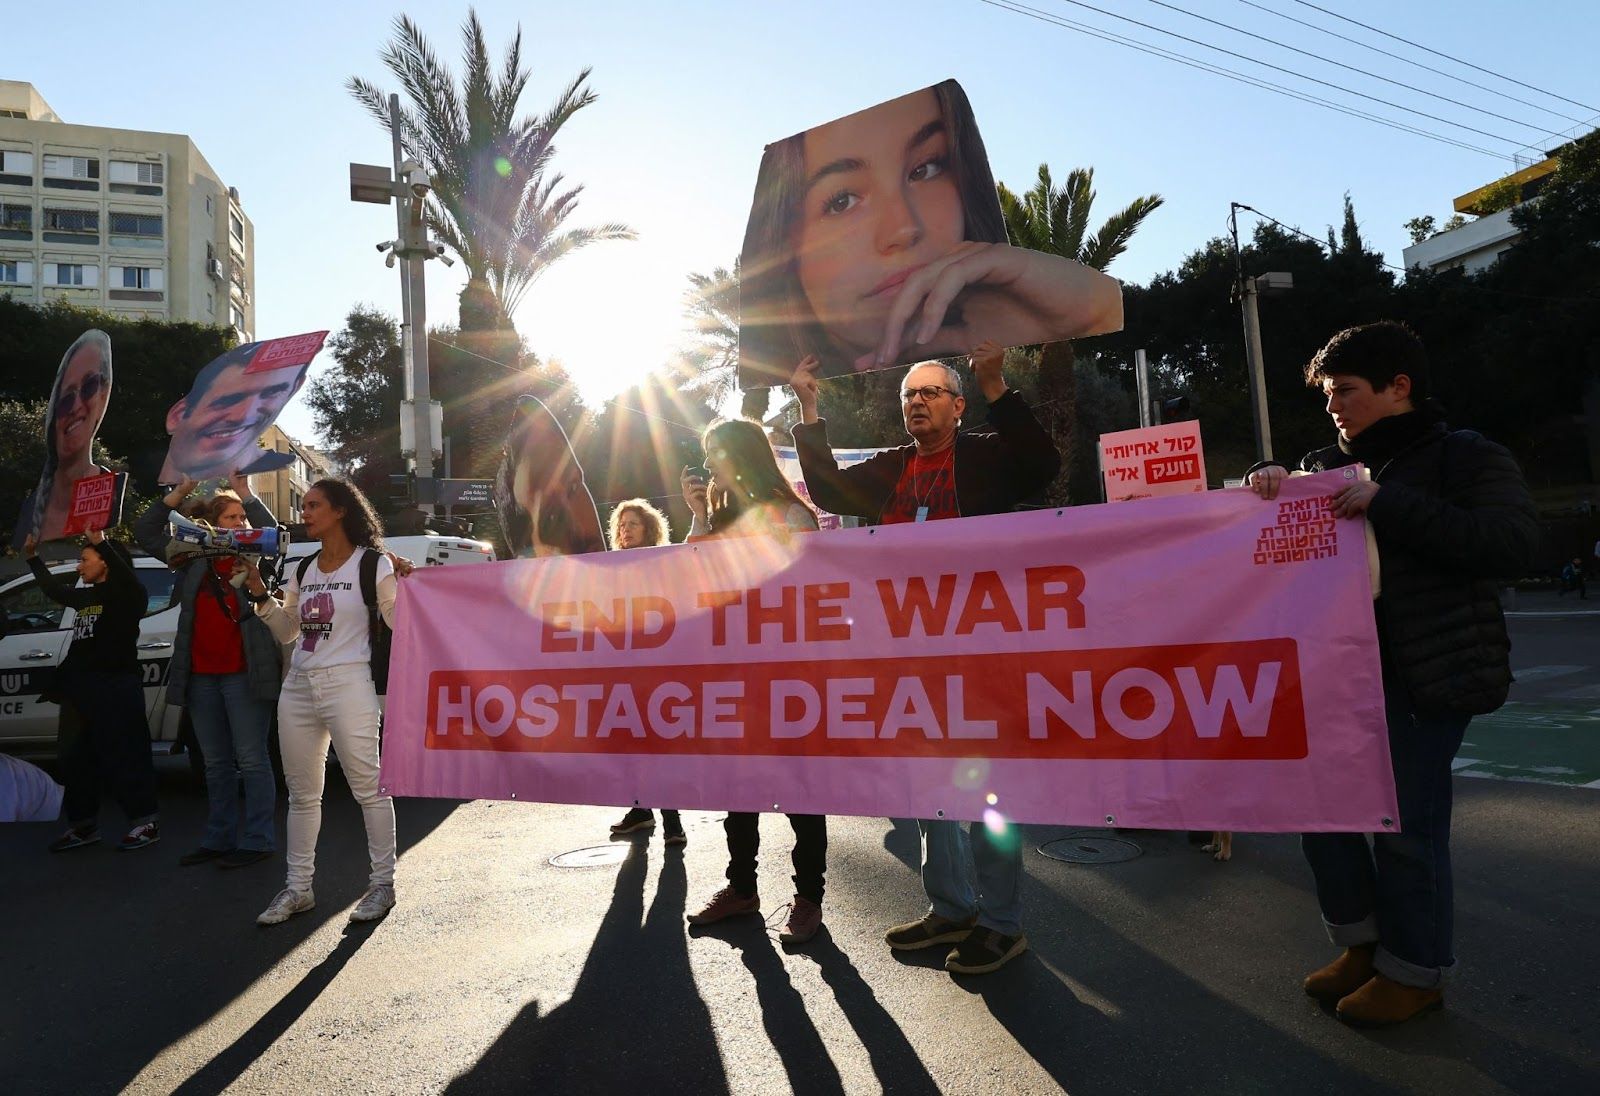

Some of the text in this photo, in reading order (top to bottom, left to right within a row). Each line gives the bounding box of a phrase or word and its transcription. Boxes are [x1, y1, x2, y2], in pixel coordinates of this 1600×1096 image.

[1163, 435, 1196, 452] קול
[1151, 459, 1194, 480] זועק
[79, 479, 112, 497] הופקרו
[75, 496, 110, 514] למותם.
[1279, 494, 1332, 513] מחאת
[1277, 508, 1336, 525] הנשים
[1261, 519, 1336, 539] להחזרת
[1256, 532, 1337, 552] החטופות
[1253, 545, 1338, 565] והחטופים
[541, 565, 1086, 653] END THE WAR
[0, 673, 30, 694] יש
[435, 661, 1282, 740] HOSTAGE DEAL NOW
